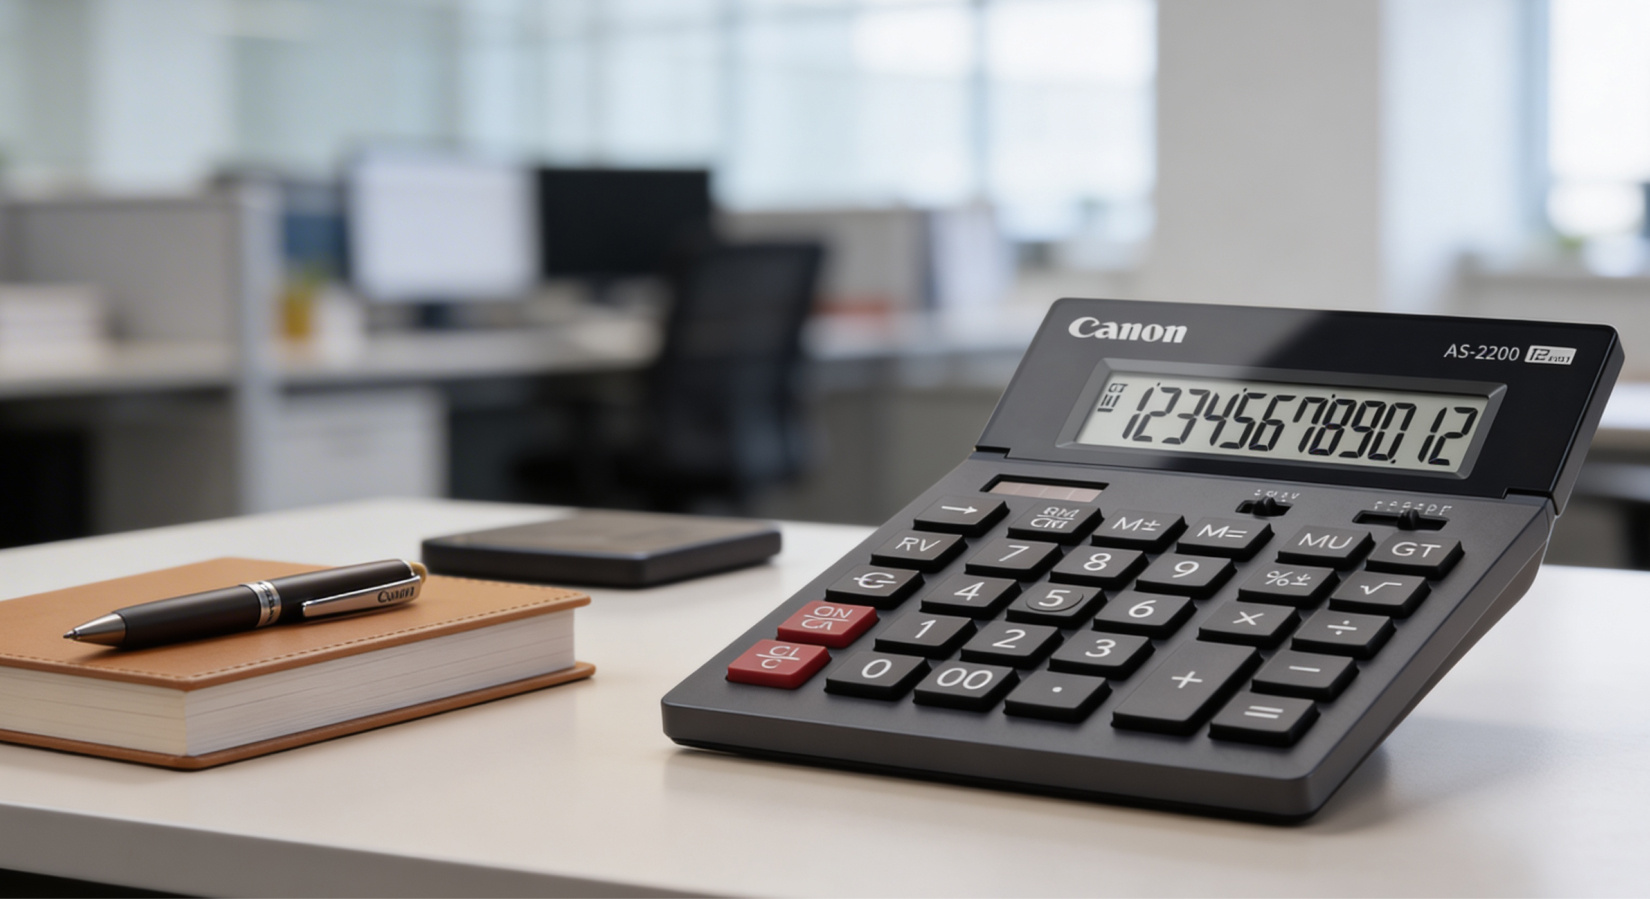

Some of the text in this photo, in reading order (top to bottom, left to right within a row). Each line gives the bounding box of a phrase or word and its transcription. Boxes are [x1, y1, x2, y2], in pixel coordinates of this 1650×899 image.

[1068, 316, 1188, 344] Canon
[1443, 343, 1520, 361] AS-2200
[895, 536, 941, 552] RV
[1298, 532, 1353, 550] MU
[1391, 541, 1442, 558] GT
[999, 544, 1030, 562] 7
[1083, 552, 1112, 572] 8
[1172, 560, 1200, 578] 9
[953, 581, 985, 601] 4
[1038, 589, 1071, 607] 5
[814, 606, 853, 618] ON
[1128, 599, 1157, 618] 6
[915, 619, 937, 639] 1
[992, 628, 1026, 649] 2
[1085, 638, 1116, 658] 3
[761, 658, 782, 669] C
[861, 658, 892, 679] 0
[936, 667, 993, 690] 00
